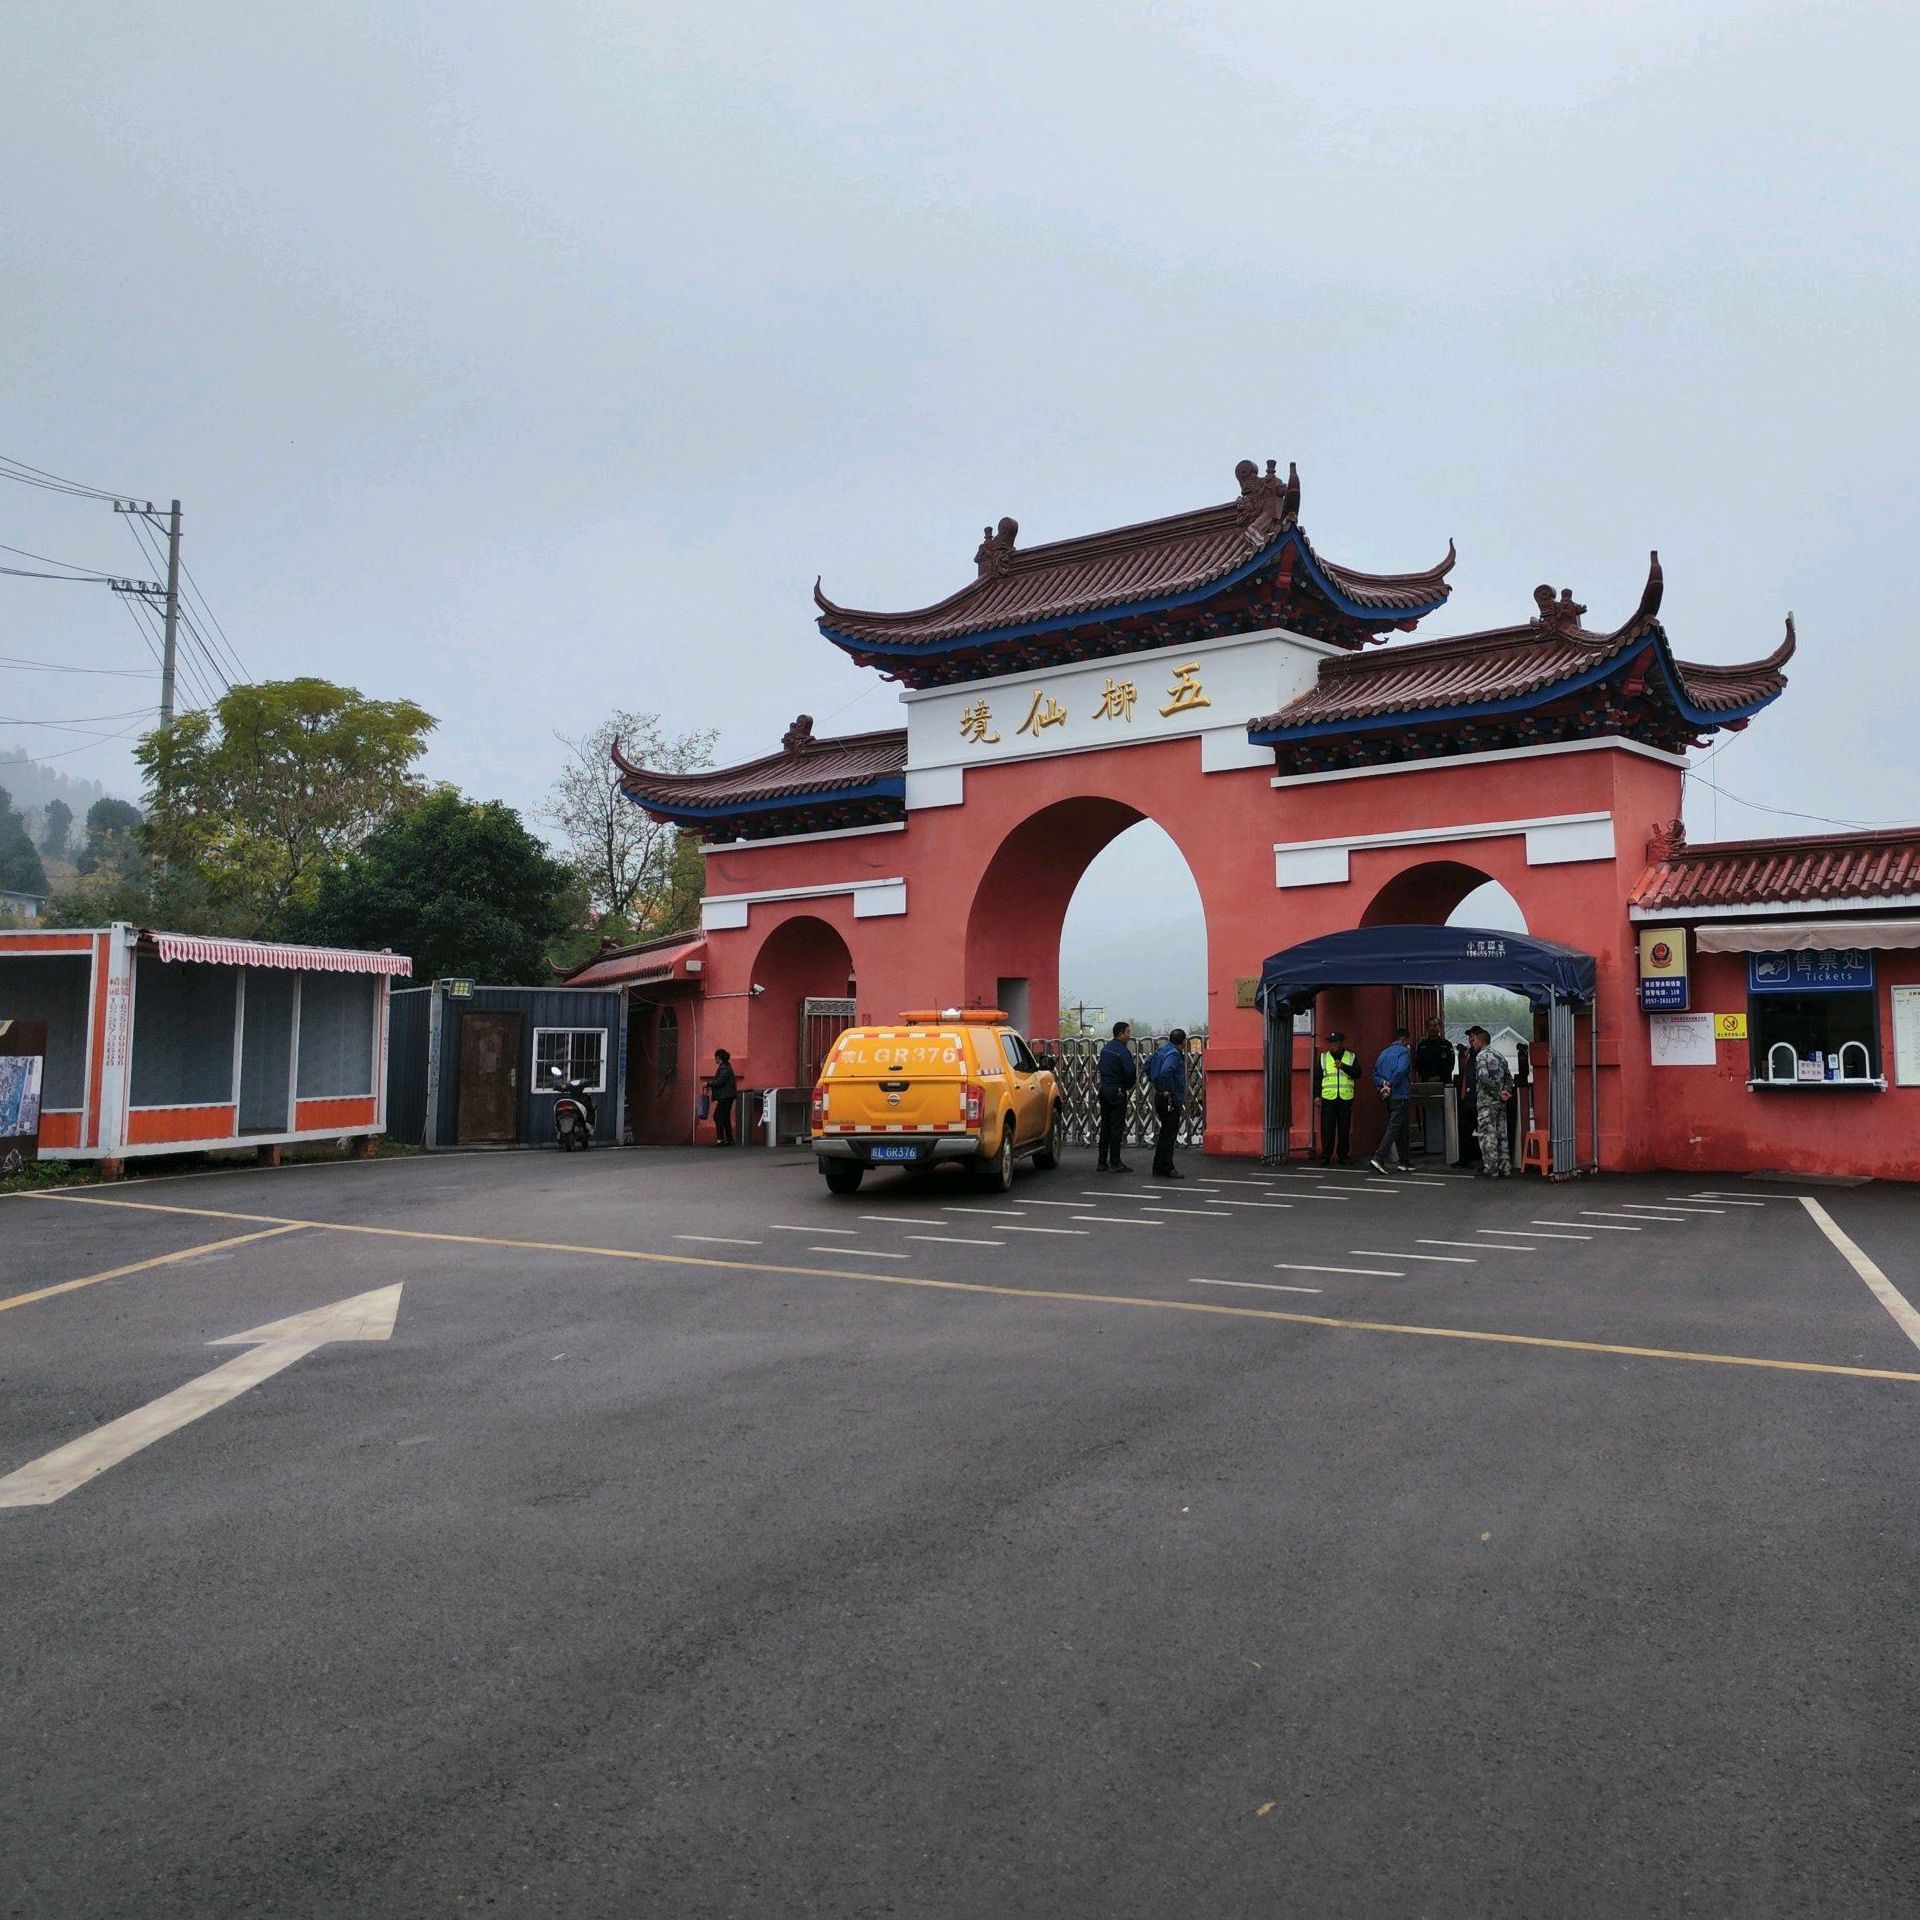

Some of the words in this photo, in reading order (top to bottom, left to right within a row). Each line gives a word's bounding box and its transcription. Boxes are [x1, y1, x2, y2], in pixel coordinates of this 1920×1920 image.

[1794, 950, 1865, 972] 售票处
[1806, 972, 1853, 982] Tickets
[874, 1047, 957, 1064] GR376
[886, 1146, 916, 1158] GR376
